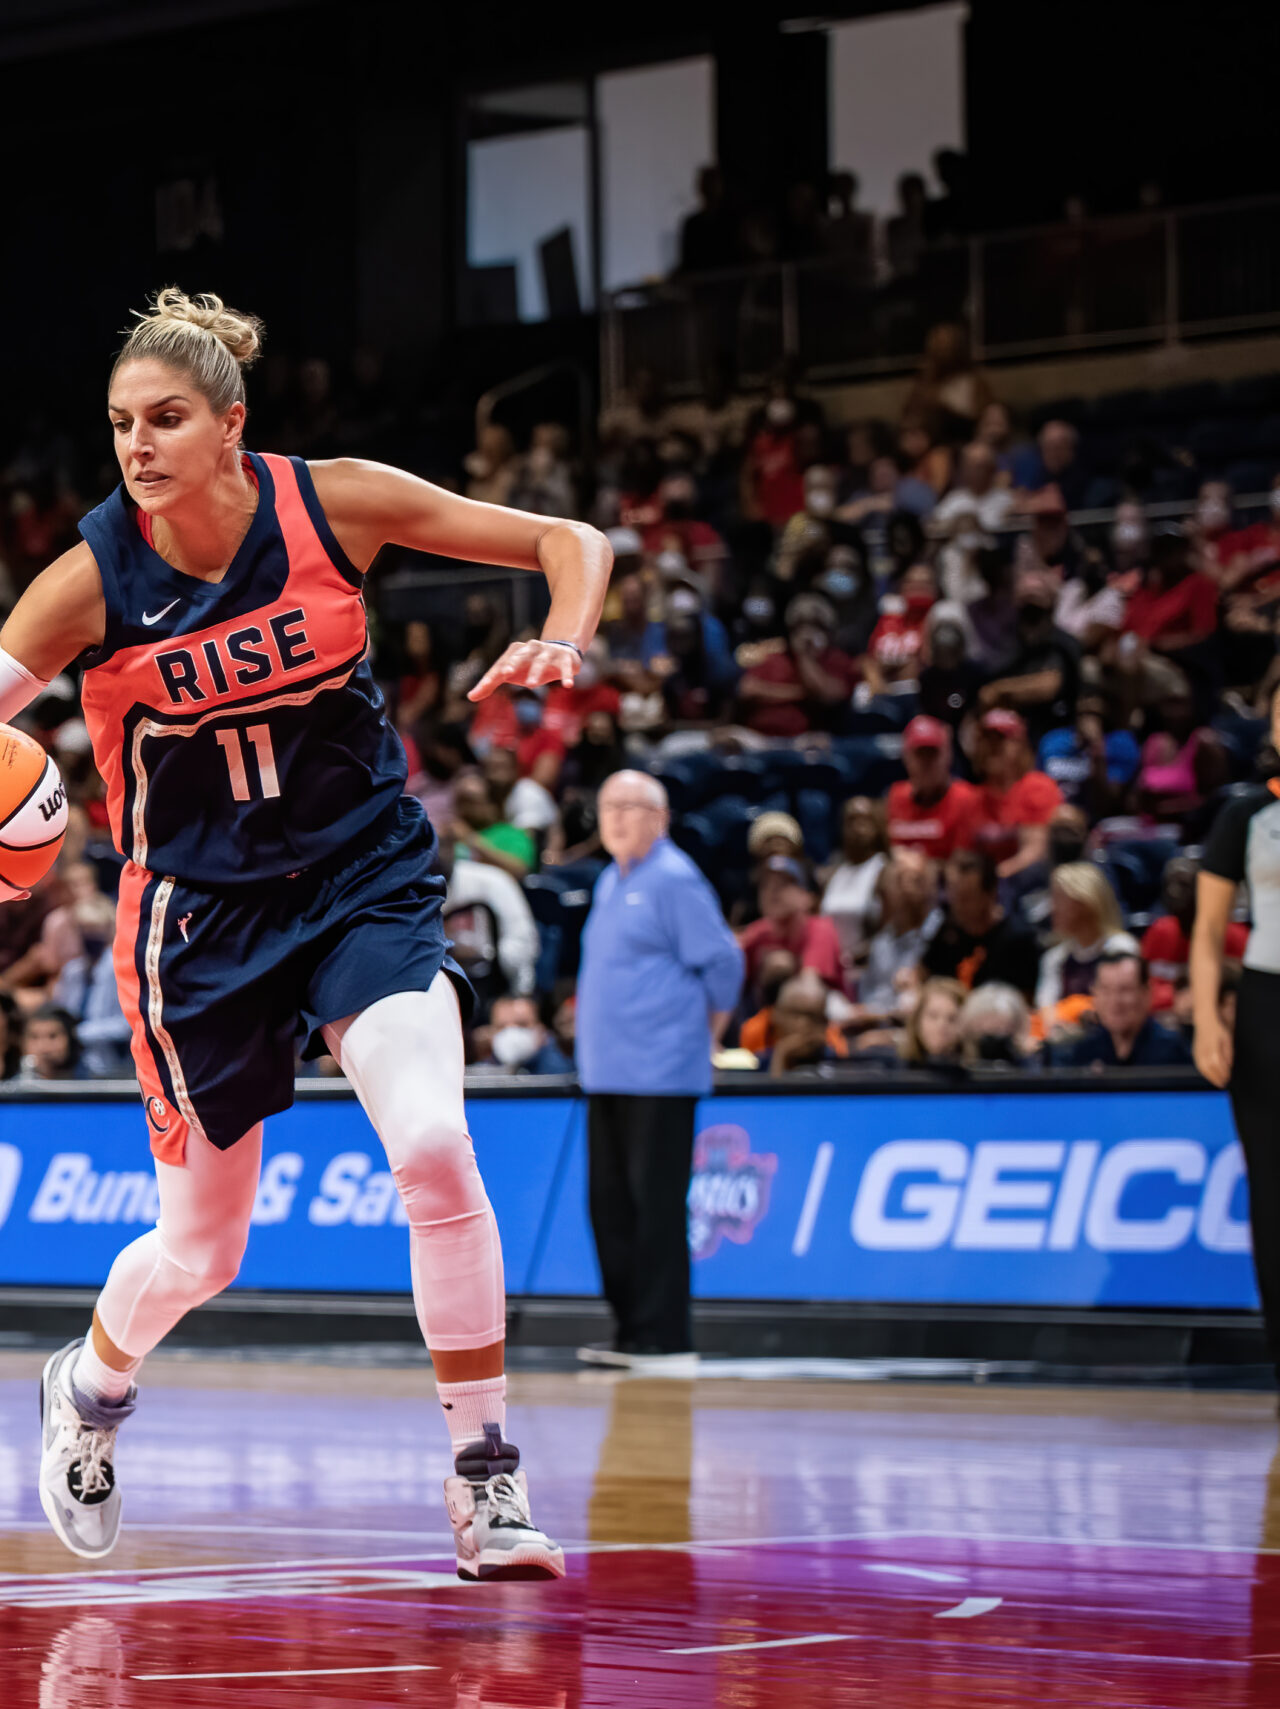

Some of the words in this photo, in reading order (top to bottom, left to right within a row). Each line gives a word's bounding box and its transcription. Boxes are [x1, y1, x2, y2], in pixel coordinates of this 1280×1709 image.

[154, 607, 317, 705] RISE
[215, 723, 281, 801] 11
[307, 1152, 410, 1227] Sa
